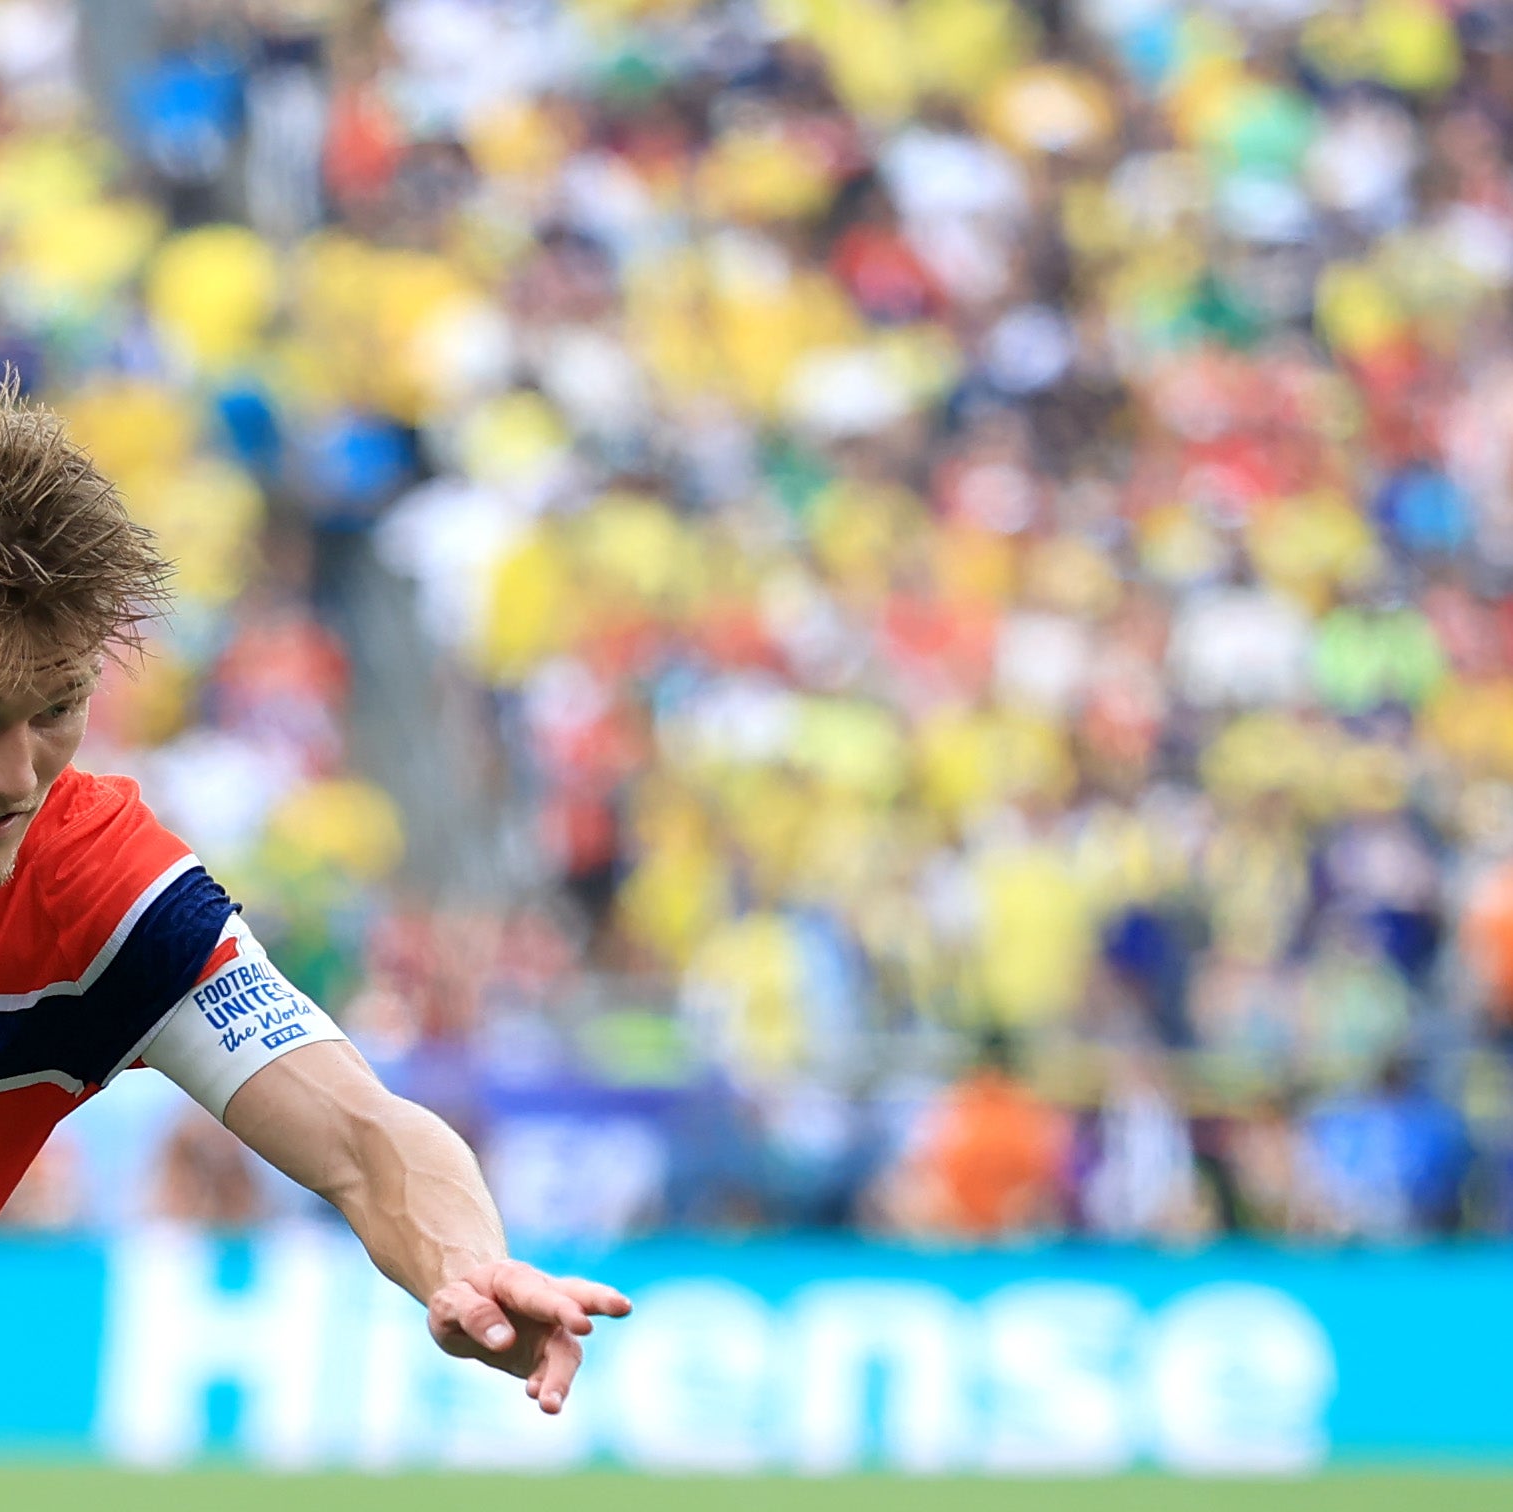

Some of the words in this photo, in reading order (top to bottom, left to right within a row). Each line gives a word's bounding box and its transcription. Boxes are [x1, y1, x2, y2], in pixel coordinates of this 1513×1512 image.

[192, 960, 276, 1013] FOOTBALL
[204, 981, 296, 1031] UNITES
[218, 1024, 258, 1053] the
[254, 999, 316, 1030] World
[265, 1025, 306, 1048] FIFA
